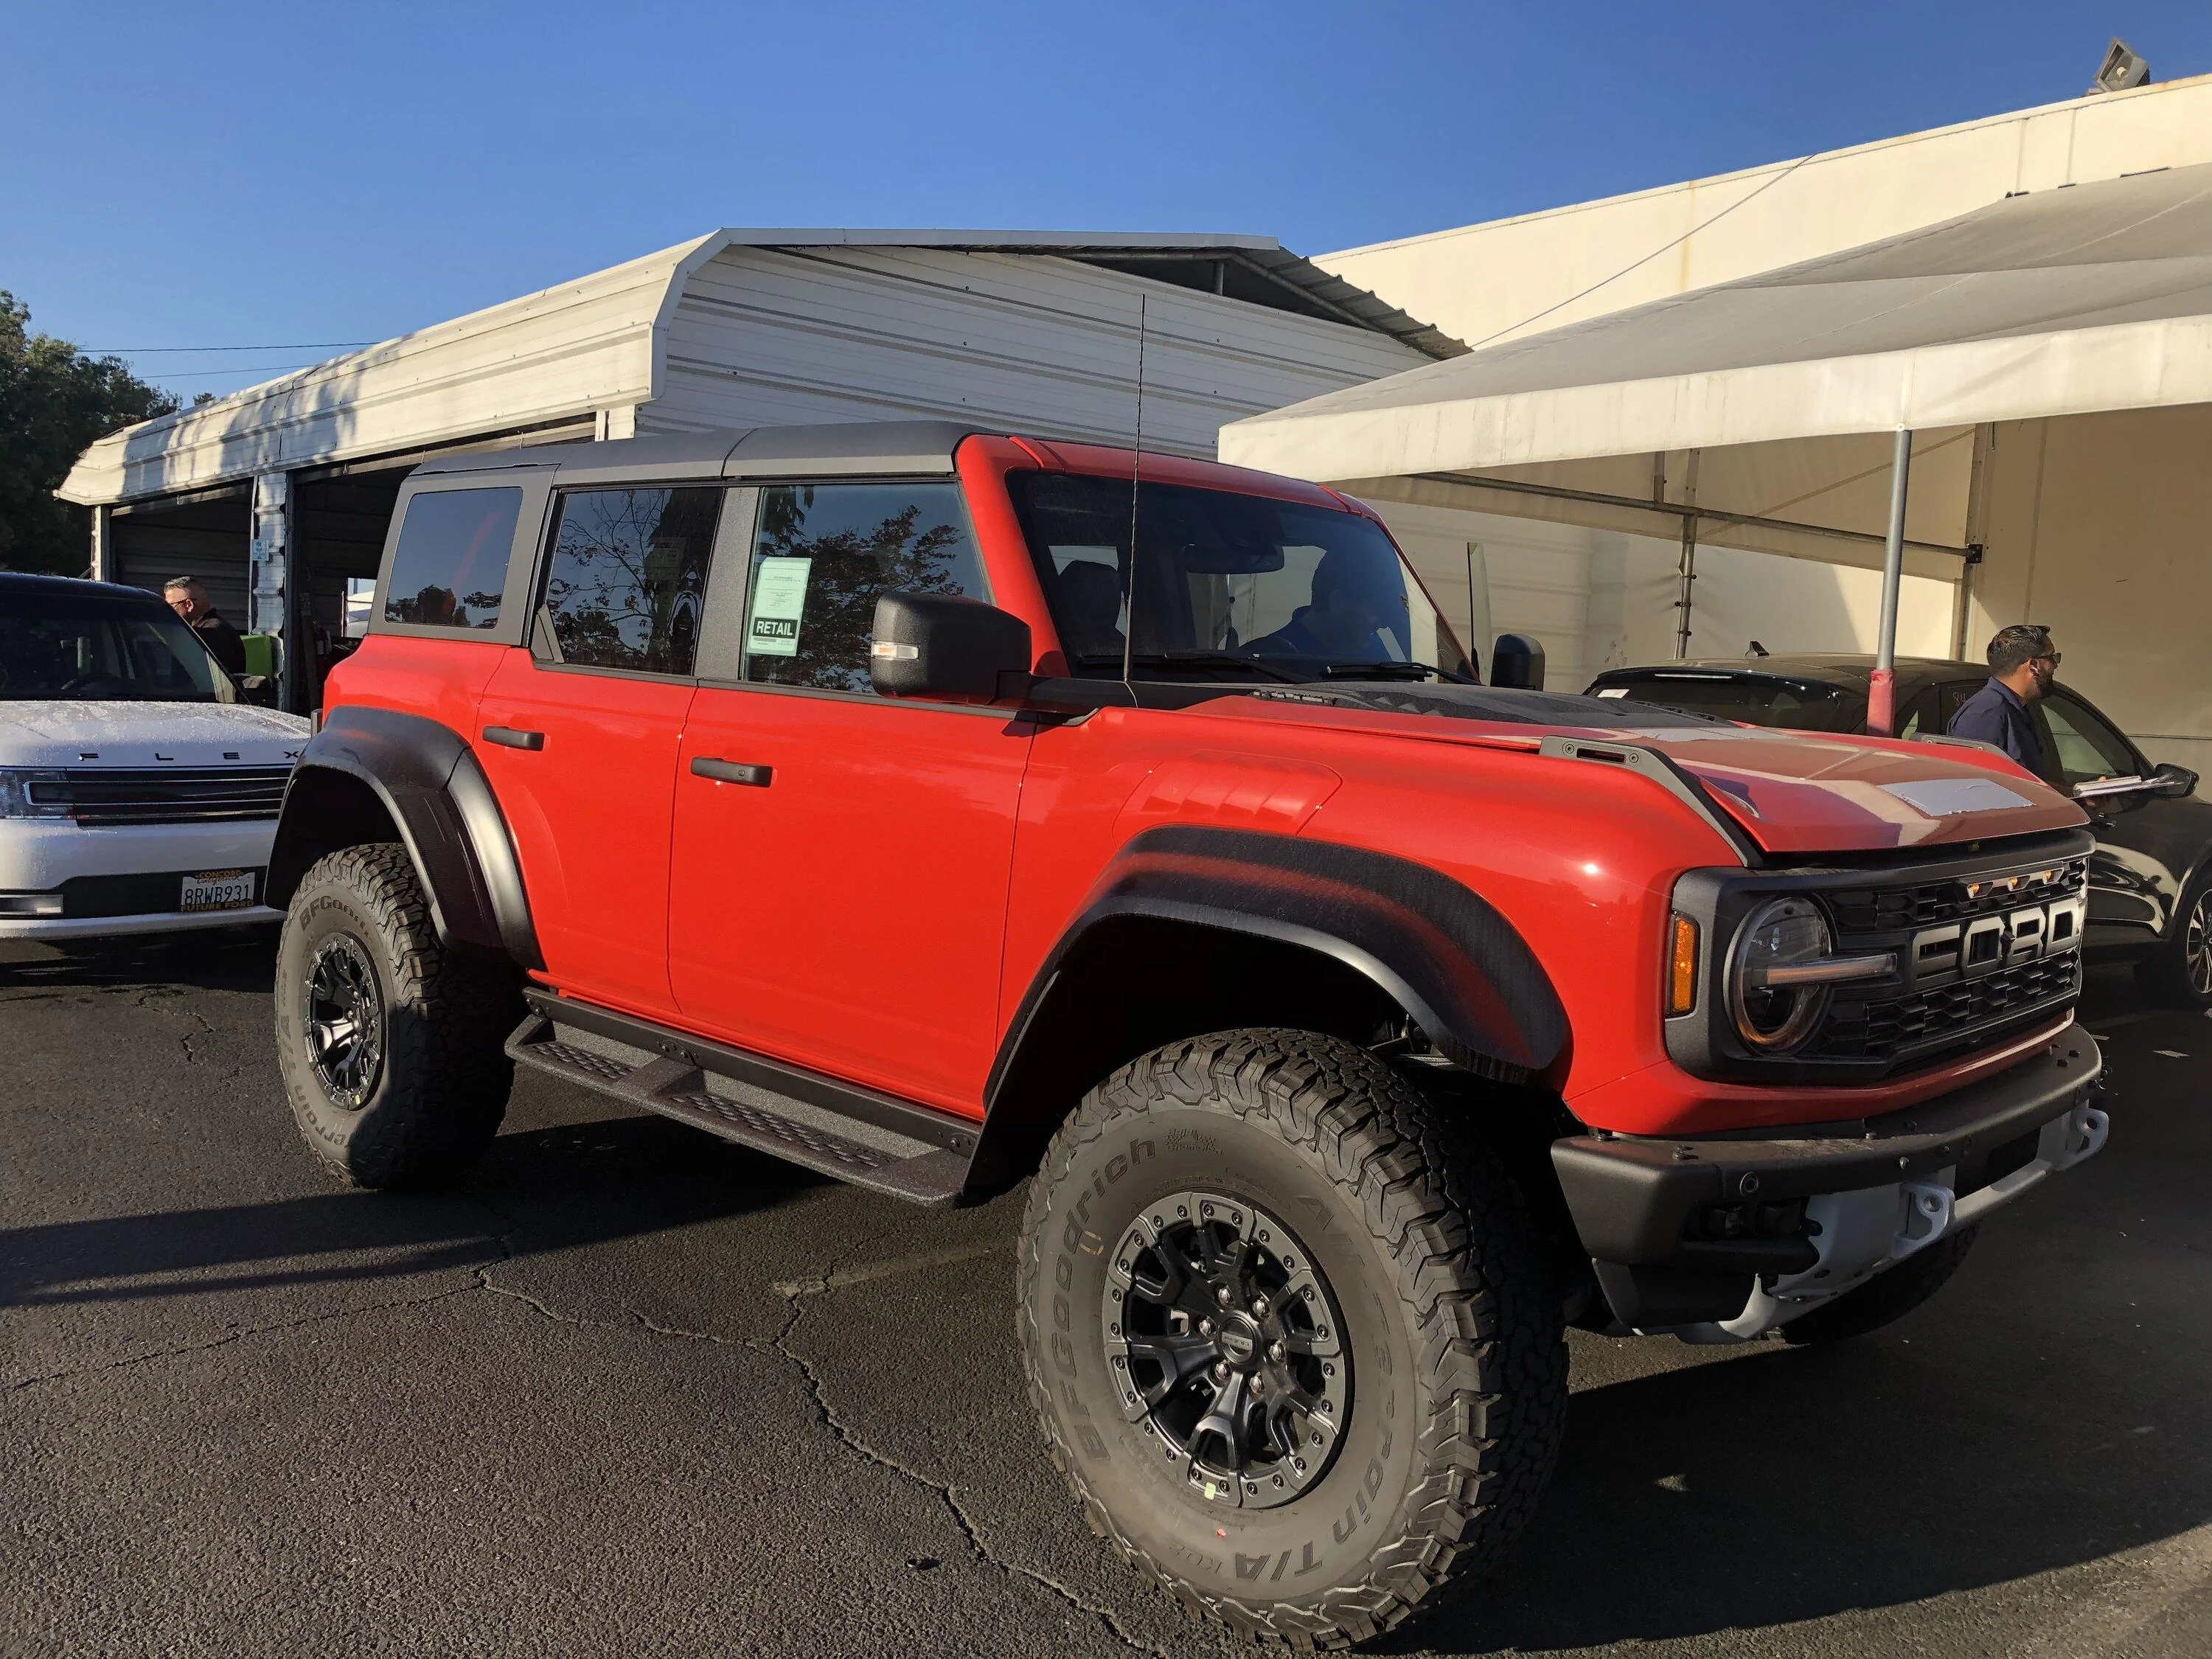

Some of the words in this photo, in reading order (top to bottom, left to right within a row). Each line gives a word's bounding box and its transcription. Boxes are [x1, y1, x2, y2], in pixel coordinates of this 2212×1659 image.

[756, 620, 793, 636] RETAIL
[78, 750, 299, 762] FLEX
[199, 869, 242, 879] CONCORD
[181, 901, 221, 912] FUTURE
[225, 897, 254, 908] FORD
[184, 884, 249, 906] 8RWB931
[1912, 897, 2081, 982] FORD
[1051, 1138, 1156, 1461] BFGoodrich
[1235, 1540, 1323, 1581] T/A
